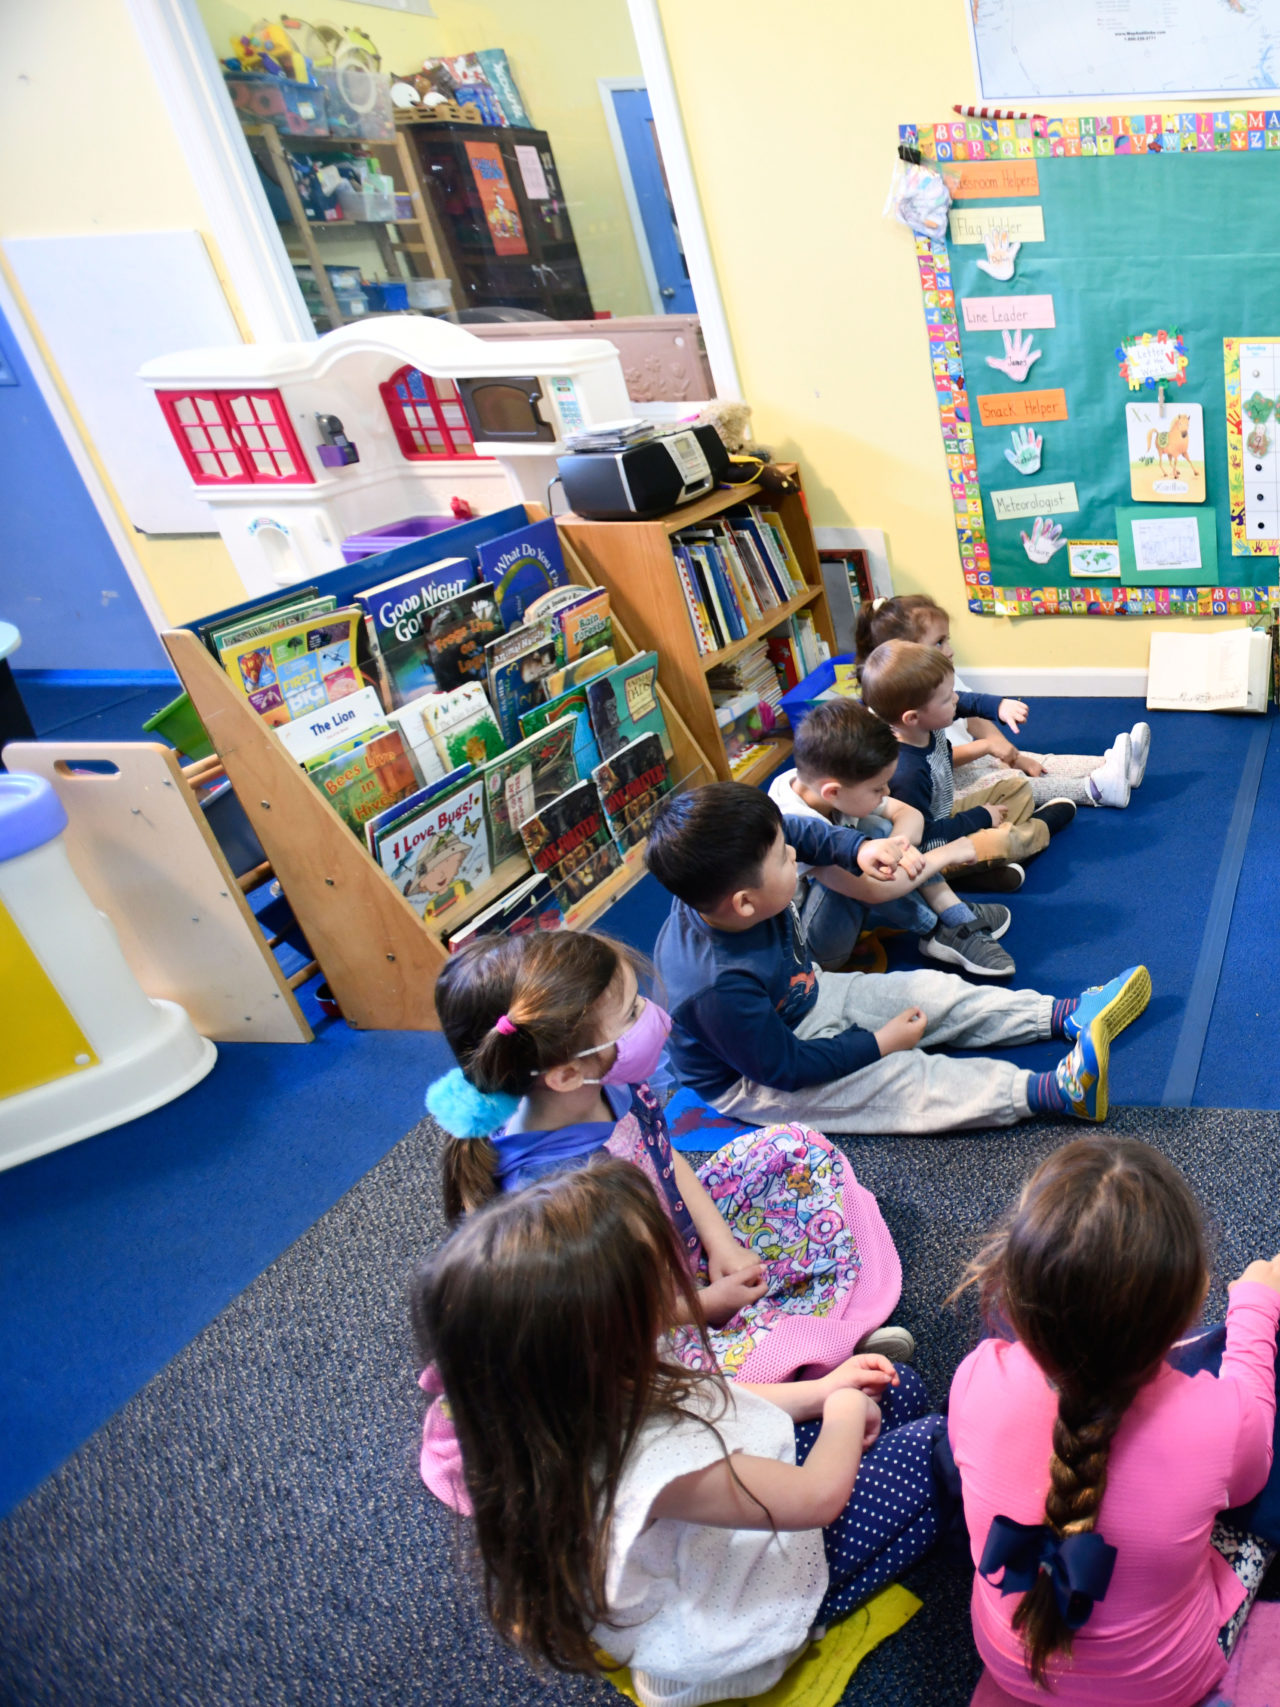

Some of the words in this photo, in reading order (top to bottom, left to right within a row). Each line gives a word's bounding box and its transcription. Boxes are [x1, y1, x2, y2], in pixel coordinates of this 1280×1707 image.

[1002, 168, 1038, 193] Helpers
[957, 216, 983, 241] Flag
[965, 306, 988, 324] Line
[991, 305, 1029, 323] Leader
[1007, 356, 1027, 367] James
[982, 401, 1017, 419] Snack
[1024, 398, 1059, 418] Helper
[996, 491, 1065, 513] Meteorologist
[494, 546, 520, 577] What
[521, 543, 537, 557] Do
[536, 546, 552, 570] You
[379, 594, 421, 629] GOOD
[433, 625, 468, 653] Frogs
[469, 618, 494, 633] Live
[282, 668, 317, 692] FIRST
[286, 681, 326, 712] BIG
[309, 719, 331, 737] The
[332, 708, 356, 728] Lion
[324, 764, 362, 796] Bees
[364, 750, 397, 770] Live
[359, 778, 376, 794] in
[354, 792, 396, 821] Hives
[402, 825, 435, 853] Love
[437, 793, 474, 831] Bugs!
